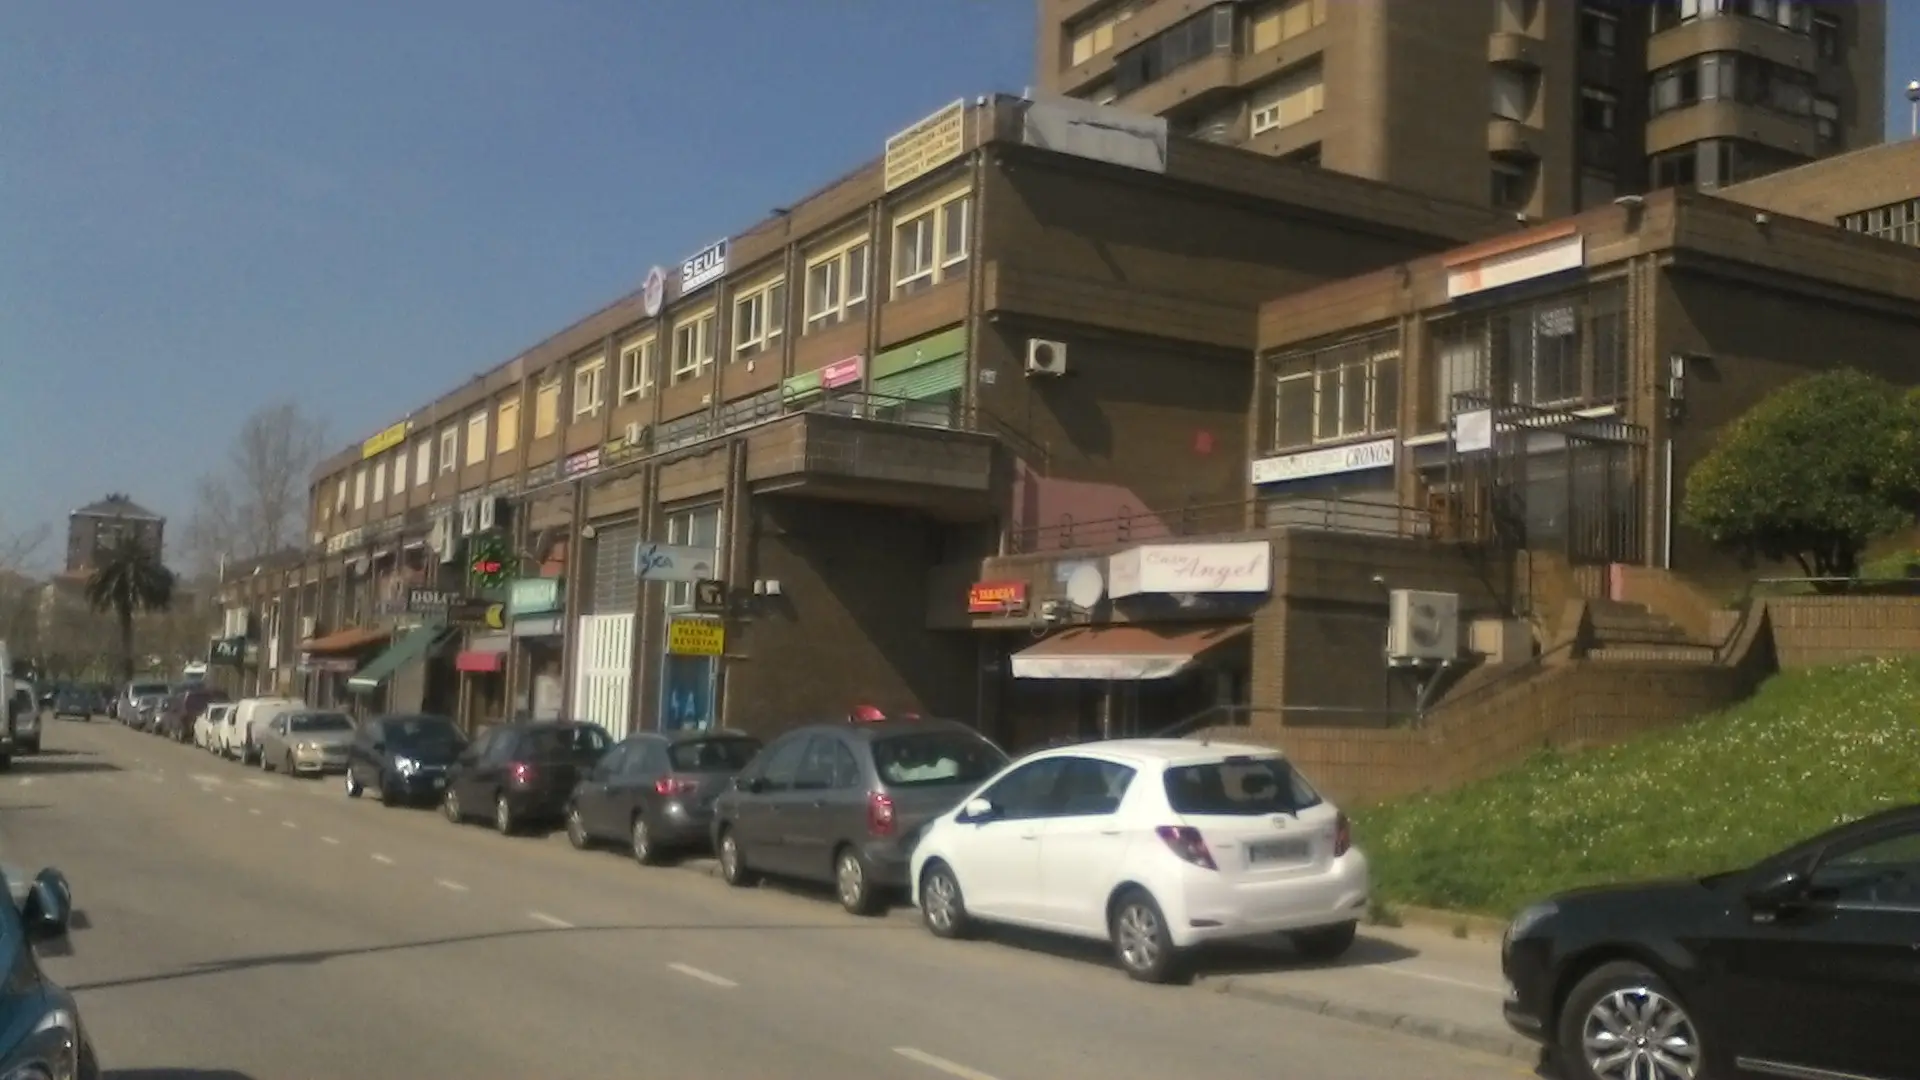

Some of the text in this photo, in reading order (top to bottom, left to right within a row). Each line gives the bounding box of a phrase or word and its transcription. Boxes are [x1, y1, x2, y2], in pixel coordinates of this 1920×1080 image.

[682, 244, 725, 281] SEUL
[1346, 443, 1391, 468] CRONOS
[1146, 552, 1265, 587] Casa Angel
